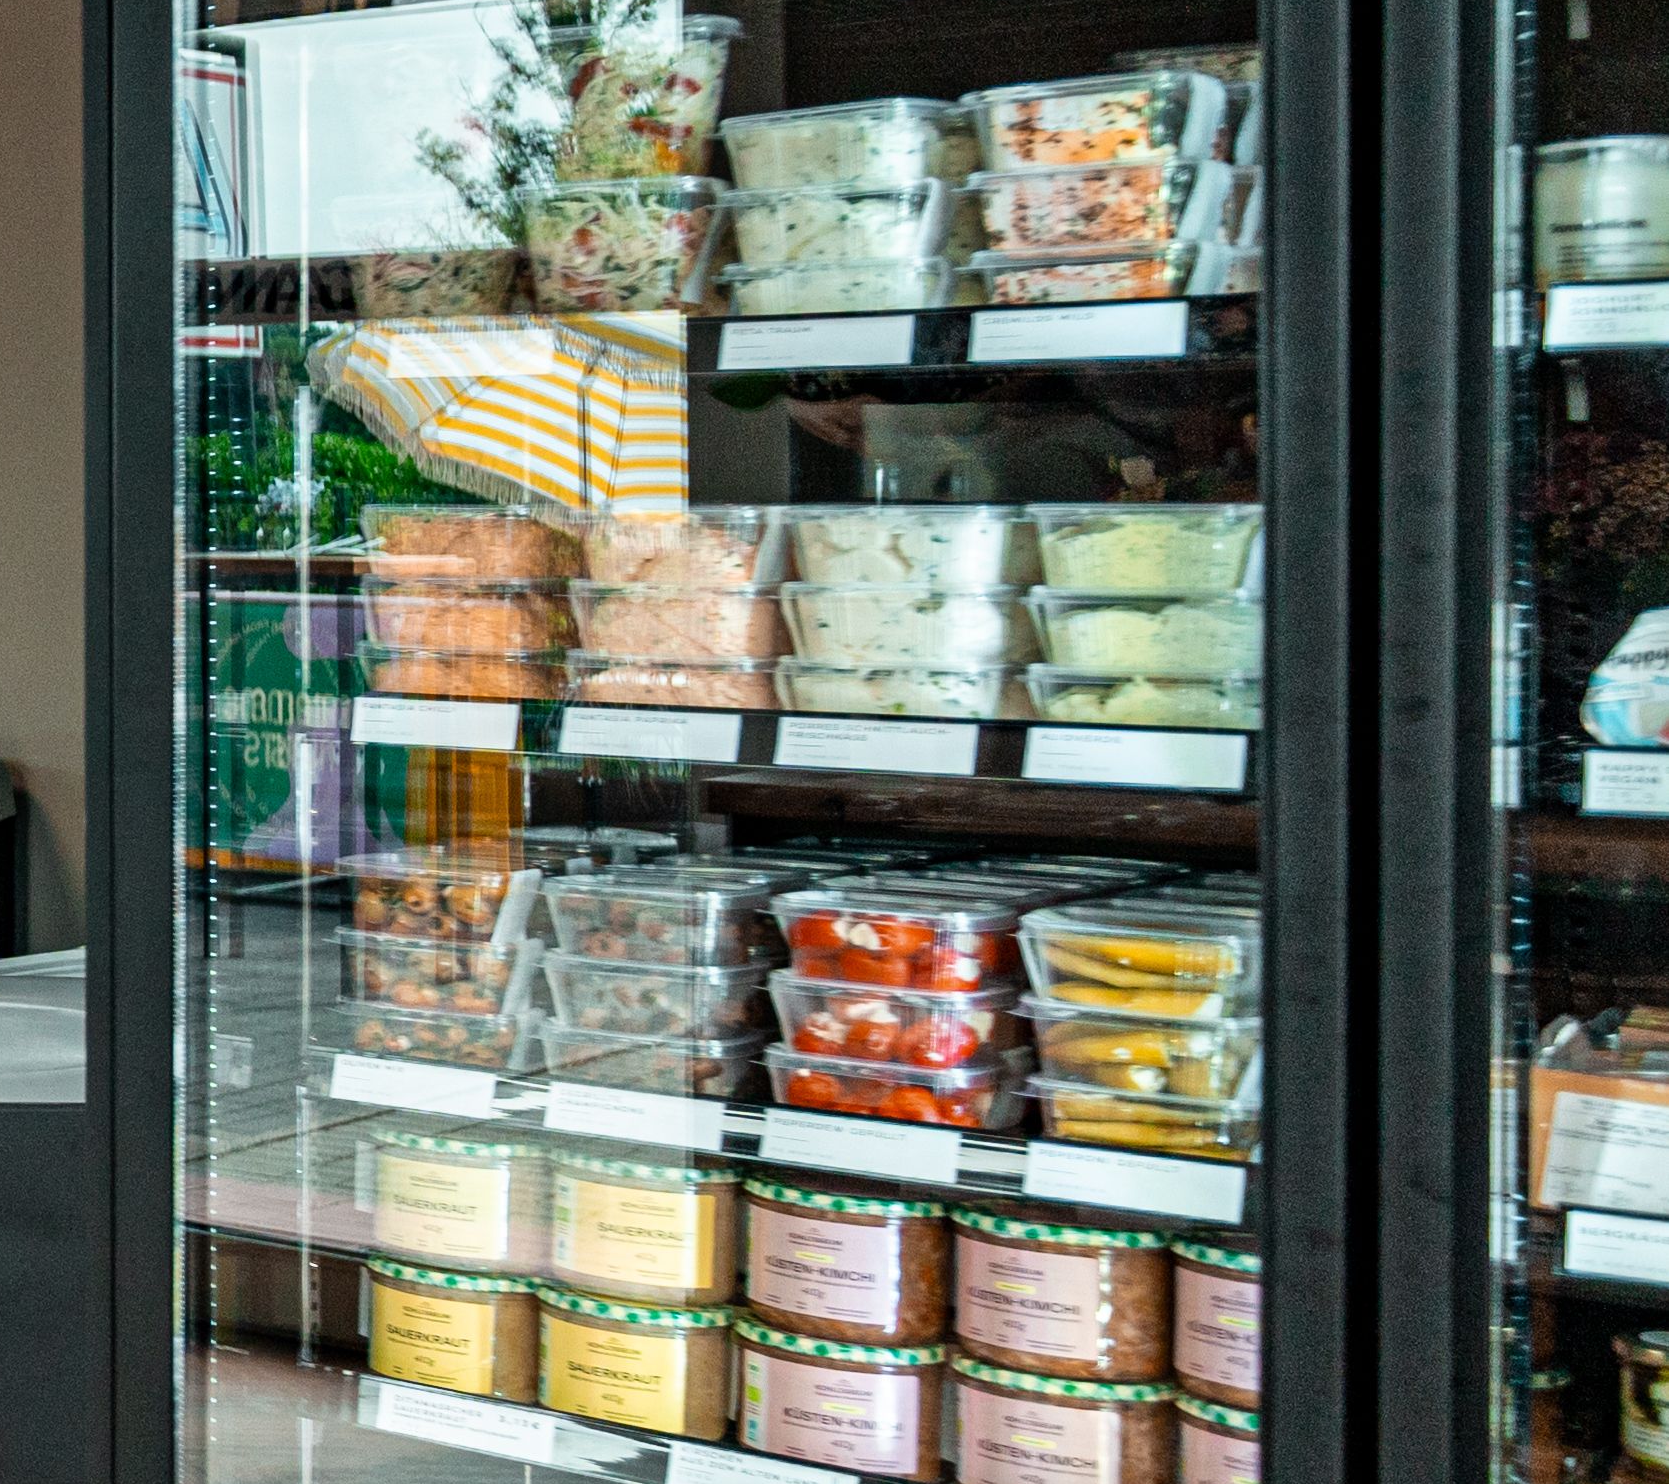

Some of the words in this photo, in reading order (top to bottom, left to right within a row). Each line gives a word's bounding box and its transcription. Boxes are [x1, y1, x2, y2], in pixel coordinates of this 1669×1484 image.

[394, 1195, 478, 1217] SAUERKRAUT
[765, 1255, 877, 1283] KÜSTEN-KIMCHI
[968, 1285, 1082, 1315] KÜSTEN-KIMCHI
[385, 1323, 471, 1349] SAUERKRAUT
[568, 1359, 663, 1387] SAUERKRAUT
[977, 1437, 1099, 1471] KÜSTEN-KIMCHI
